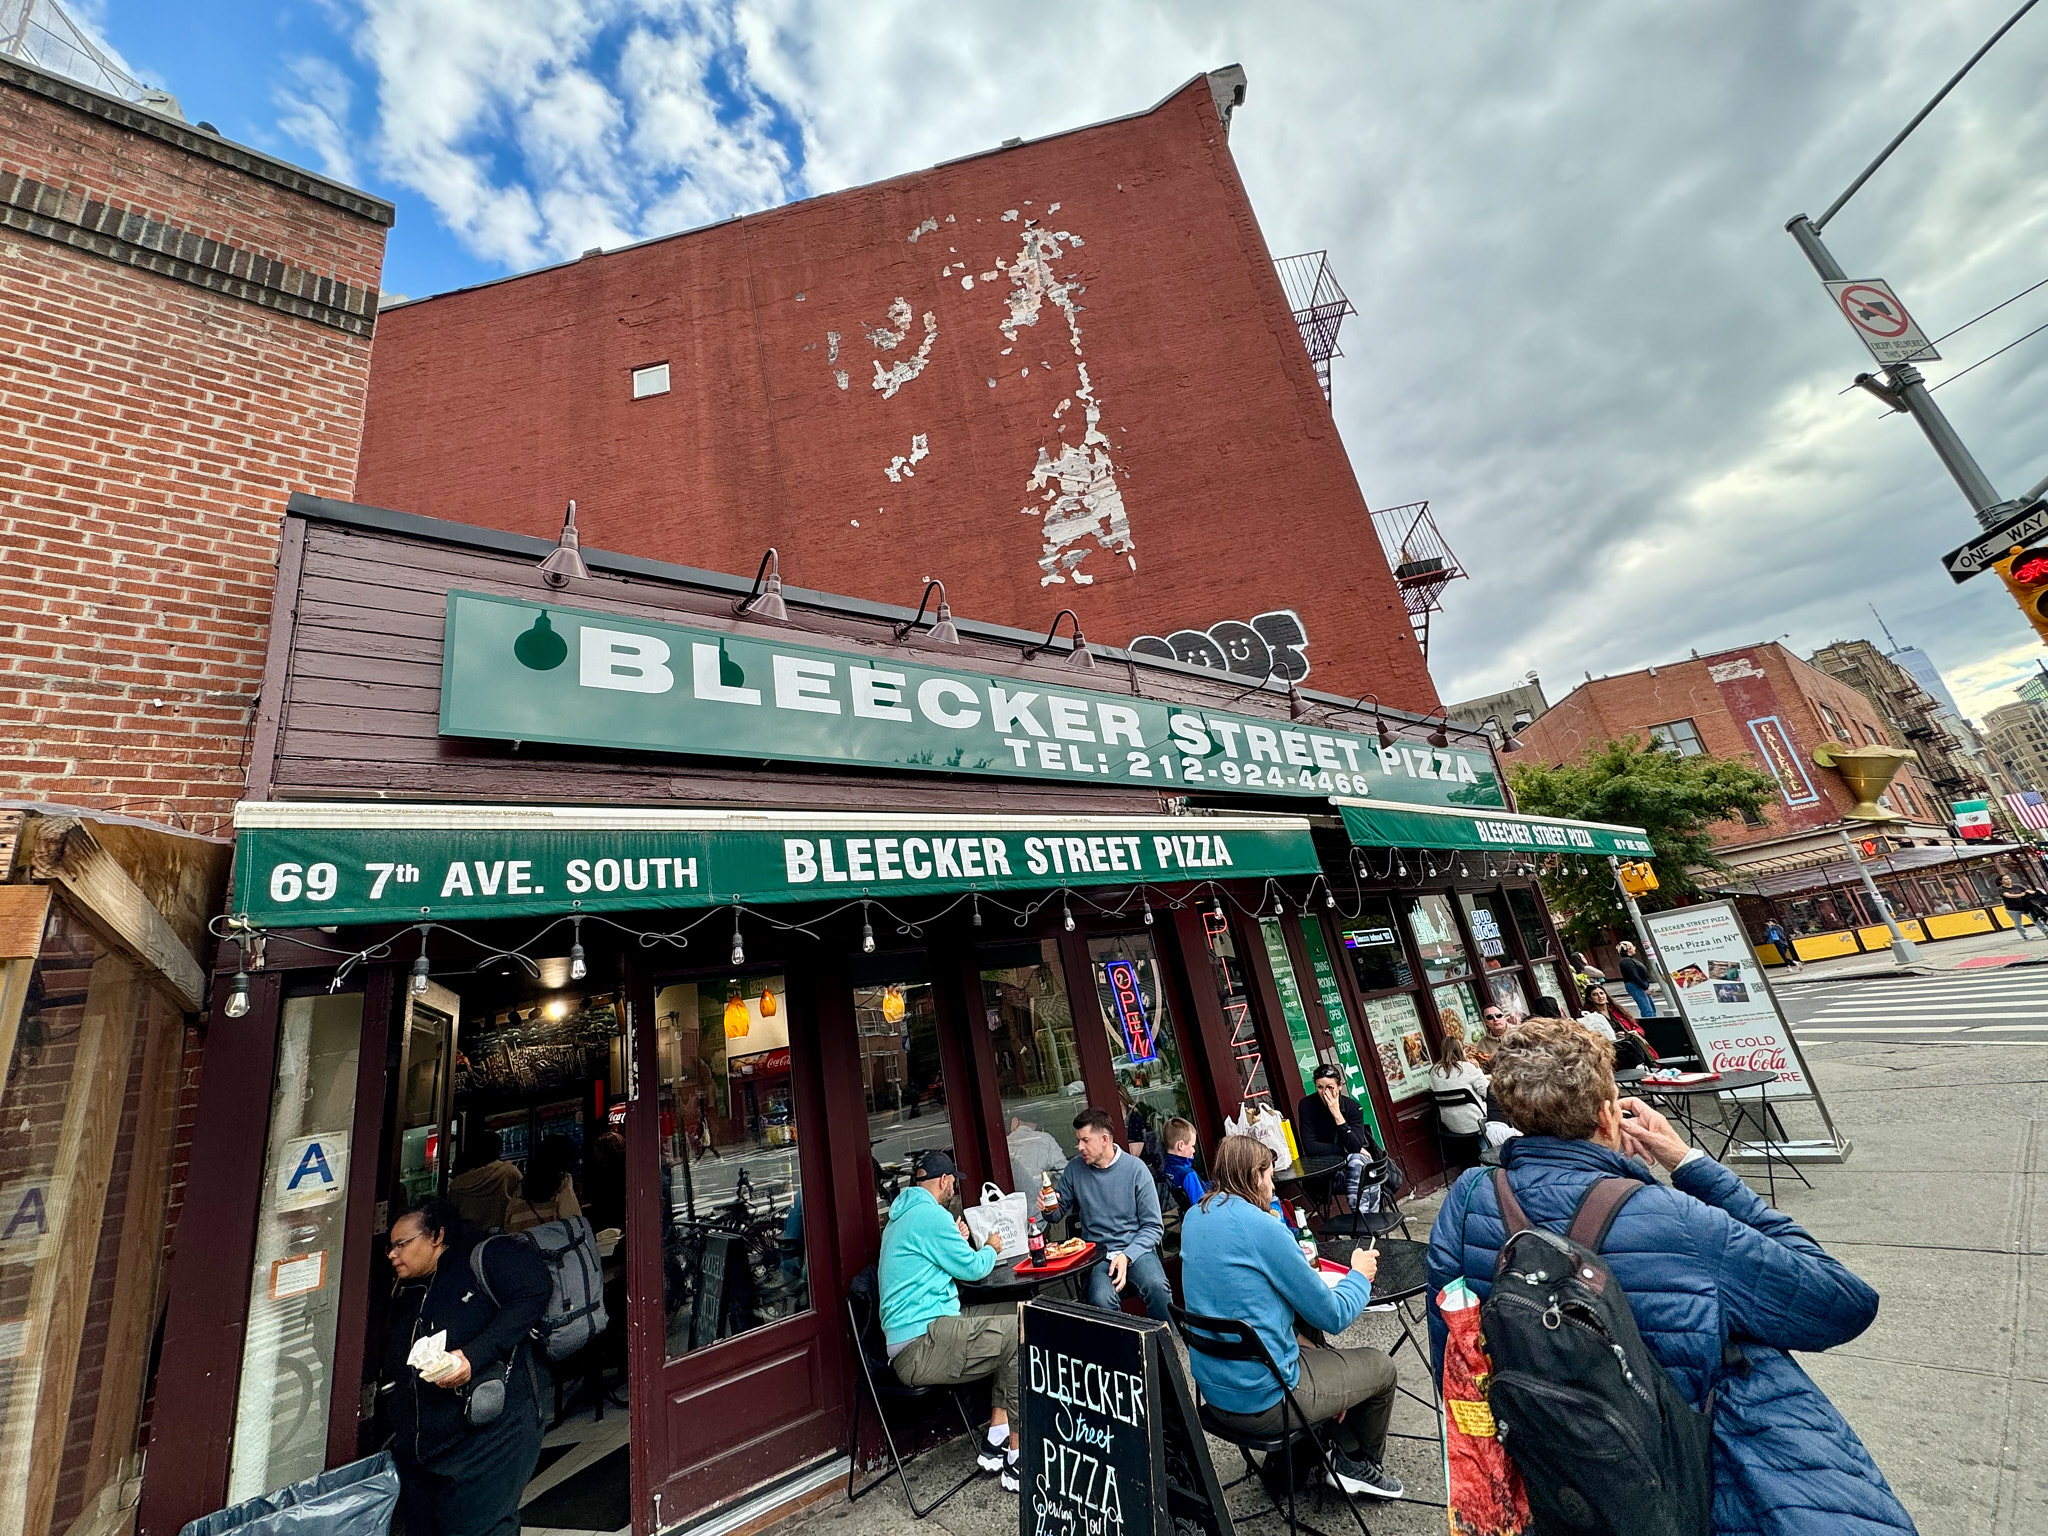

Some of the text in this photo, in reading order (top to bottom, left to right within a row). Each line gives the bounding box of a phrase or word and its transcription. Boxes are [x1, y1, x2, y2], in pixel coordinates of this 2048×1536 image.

[1870, 339, 1926, 350] EXCEPT DELIVERIES
[1960, 543, 1994, 568] ONE
[2006, 514, 2043, 542] WAY
[579, 625, 1146, 748] BLEECKER
[1170, 714, 1363, 773] STREET
[1380, 743, 1479, 784] PIZZA
[1004, 738, 1369, 797] TEL: 212-924-4466
[1474, 820, 1595, 847] BLEECKER STREET PIZZA
[270, 857, 698, 902] 69 7th AVE. SOUTH
[783, 835, 1234, 884] BLEECKER STREET PIZZA
[1653, 921, 1686, 934] BLEECKER
[1686, 919, 1710, 928] STREET
[1710, 915, 1730, 924] PIZZA
[1686, 939, 1711, 949] Pizza
[1313, 961, 1330, 972] DINING
[1113, 967, 1150, 1058] OPEN
[1203, 912, 1269, 1099] PIZZ
[1329, 1009, 1343, 1021] OPEN
[1334, 1026, 1347, 1039] NEXT
[1337, 1042, 1352, 1054] DOOR
[1709, 1035, 1776, 1050] ICE COLD
[1712, 1047, 1786, 1073] Coca-Cola
[286, 1143, 334, 1191] A
[2, 1187, 47, 1240] A
[1029, 1344, 1145, 1427] BLEECKER
[1055, 1384, 1115, 1454] Street
[1042, 1438, 1124, 1524] PIZZA
